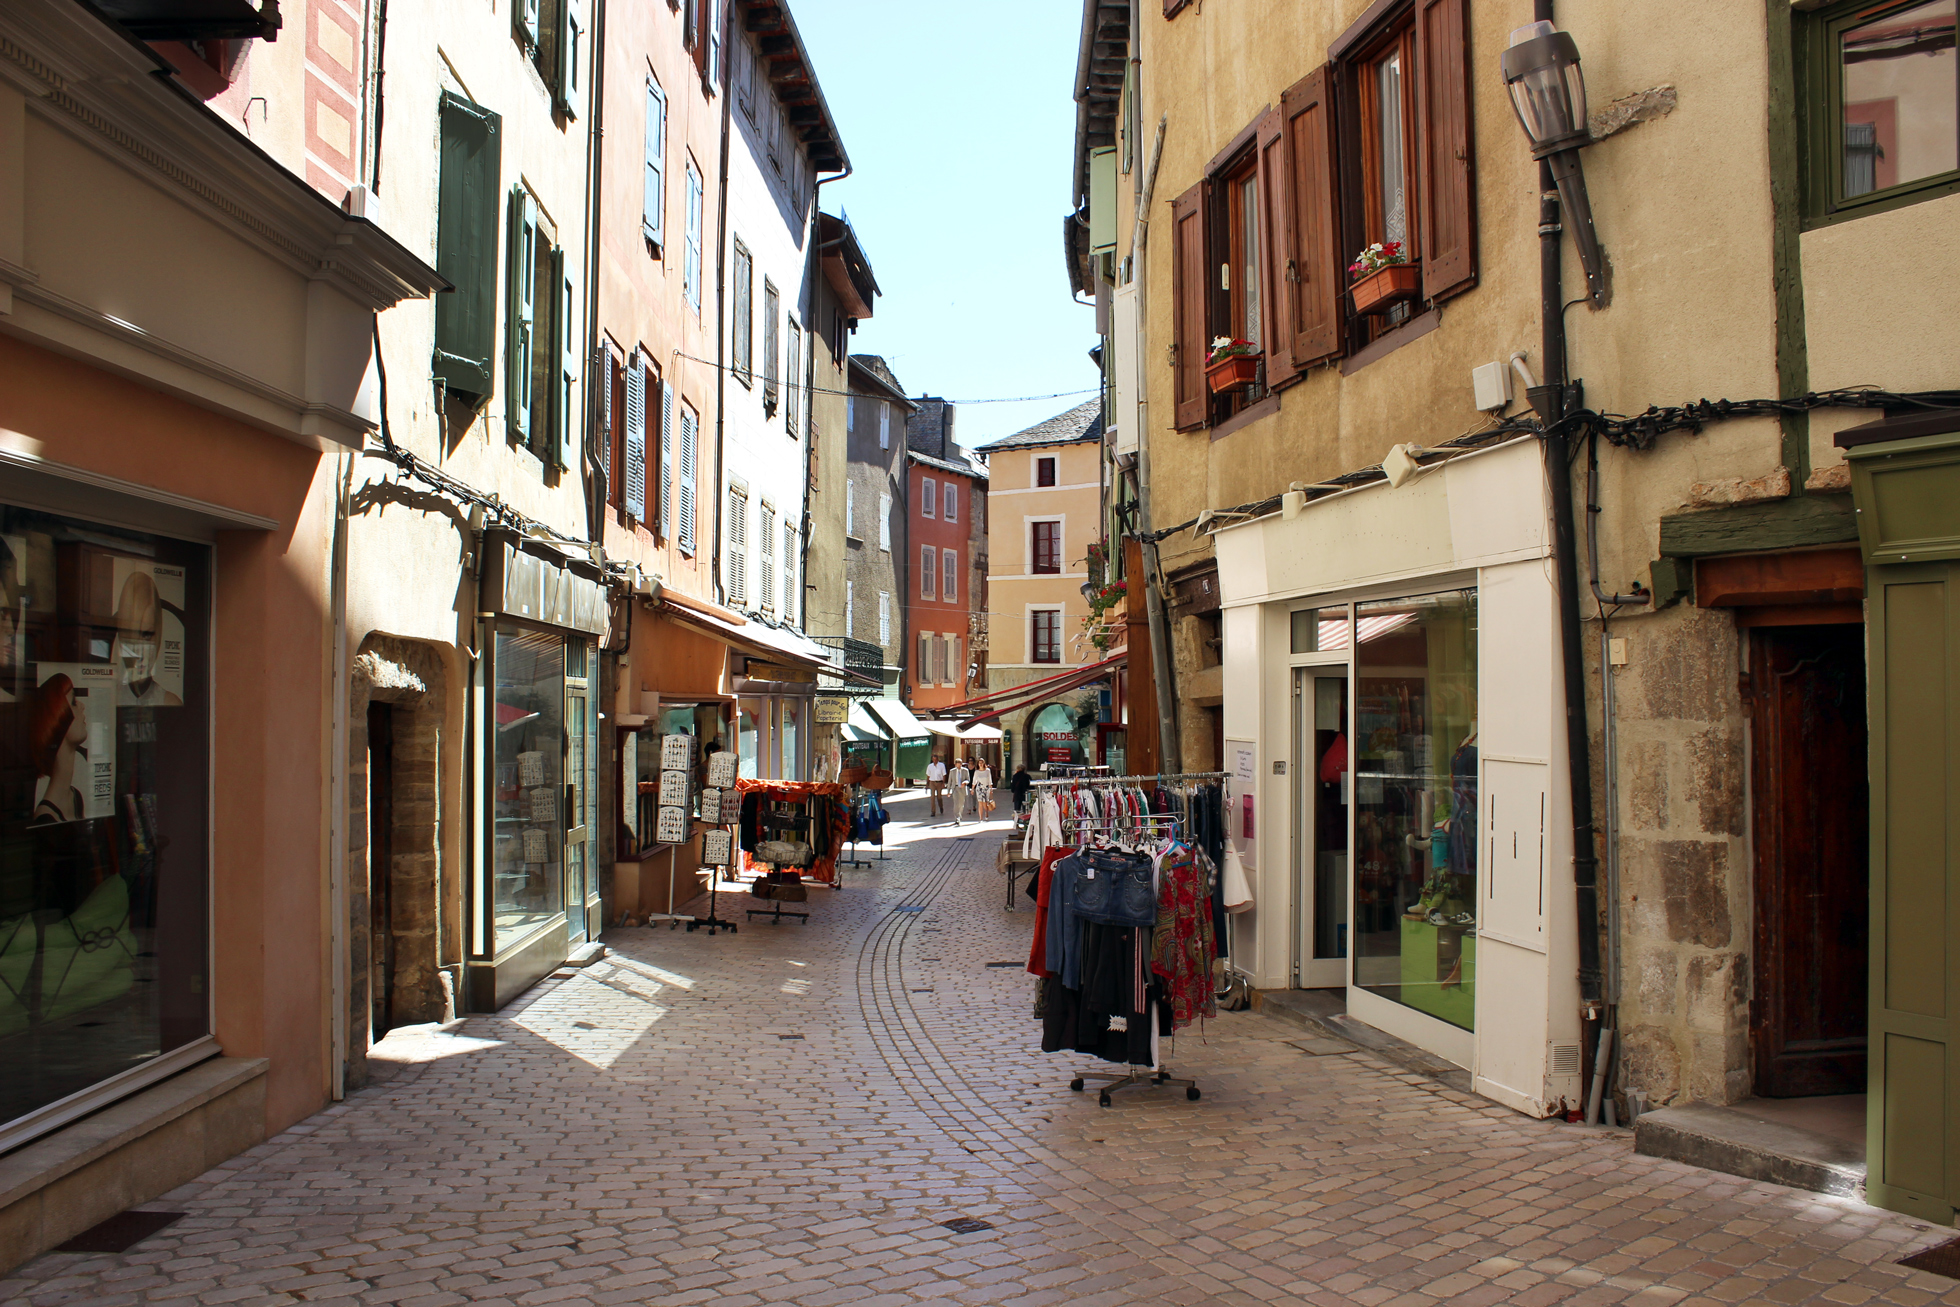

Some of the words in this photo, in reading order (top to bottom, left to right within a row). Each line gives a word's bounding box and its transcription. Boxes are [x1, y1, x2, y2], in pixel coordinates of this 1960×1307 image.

[153, 567, 181, 576] GOLDWELL
[82, 668, 110, 676] GOLDWELL
[816, 714, 843, 722] Papeterie
[1043, 732, 1079, 741] SOLDES
[94, 783, 111, 793] REDS
